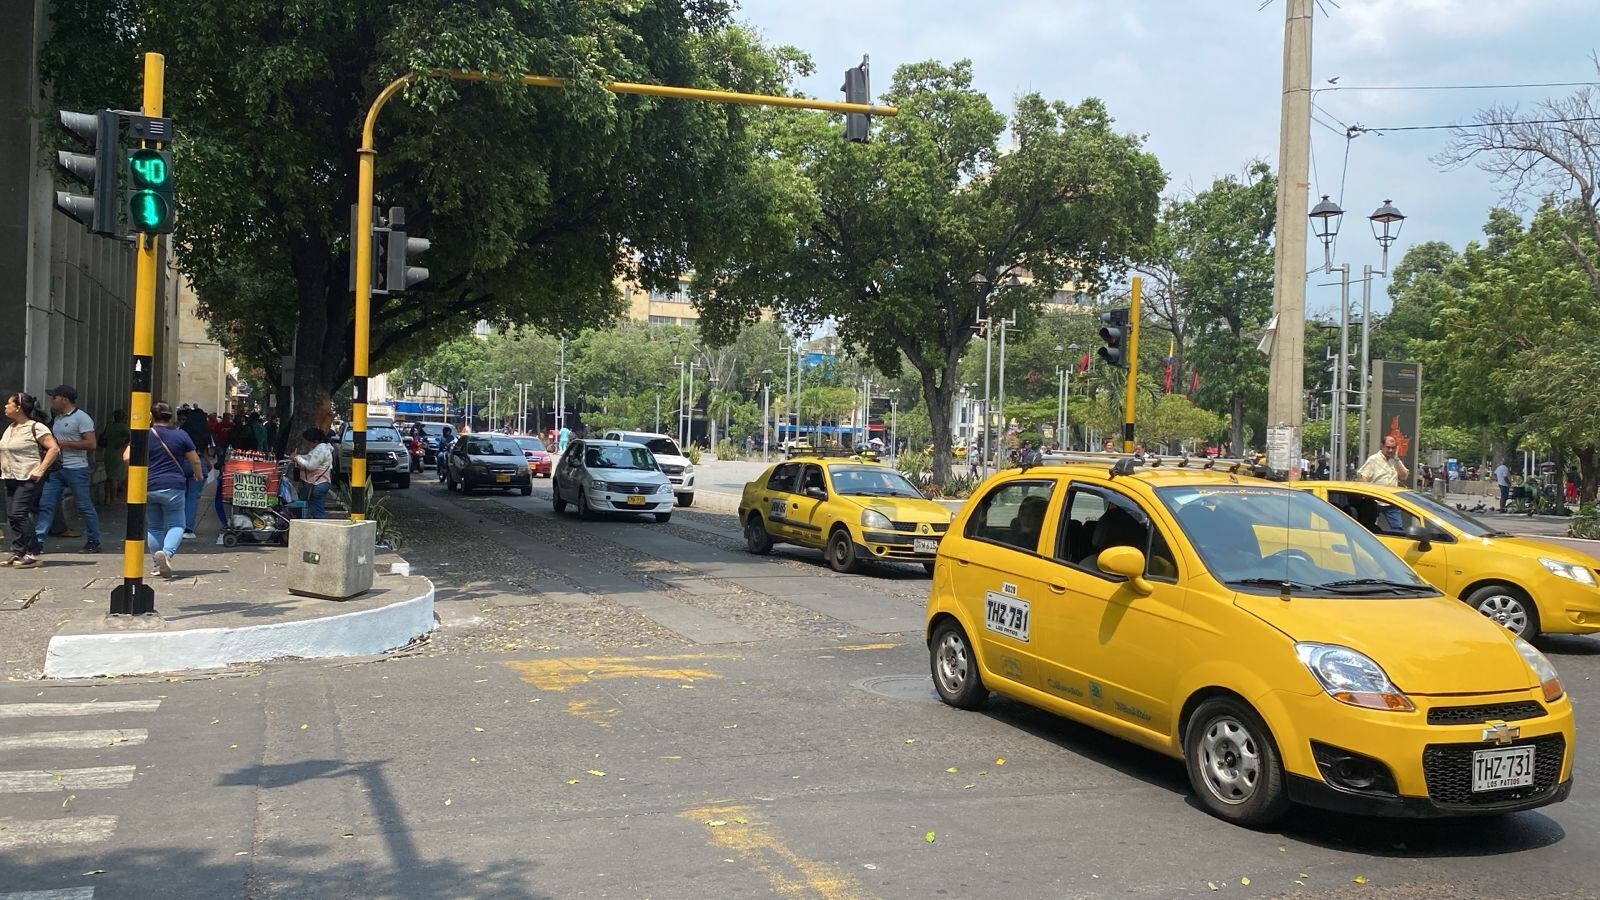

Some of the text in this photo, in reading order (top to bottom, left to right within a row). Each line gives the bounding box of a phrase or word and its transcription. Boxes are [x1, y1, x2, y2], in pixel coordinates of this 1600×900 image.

[135, 159, 164, 183] 40
[235, 474, 267, 485] MINUTOS
[234, 484, 267, 492] Claro
[234, 491, 267, 500] movistar
[1487, 778, 1519, 788] LOS PATIOS
